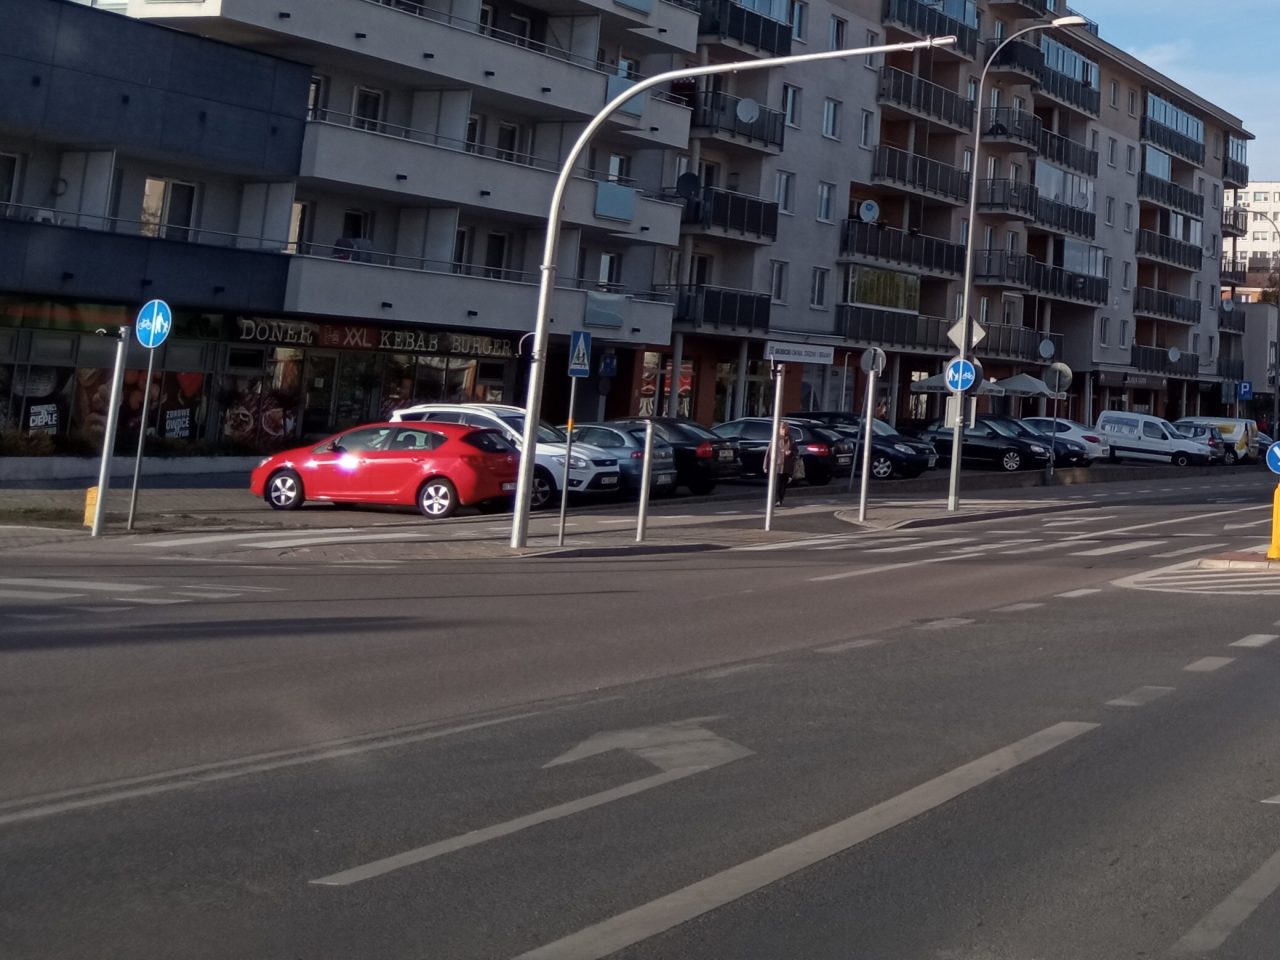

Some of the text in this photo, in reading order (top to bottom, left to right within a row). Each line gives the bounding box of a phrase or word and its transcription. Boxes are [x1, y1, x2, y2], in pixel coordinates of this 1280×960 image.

[343, 326, 373, 348] XXL
[378, 329, 440, 352] KEBAB
[448, 335, 512, 357] BURGER
